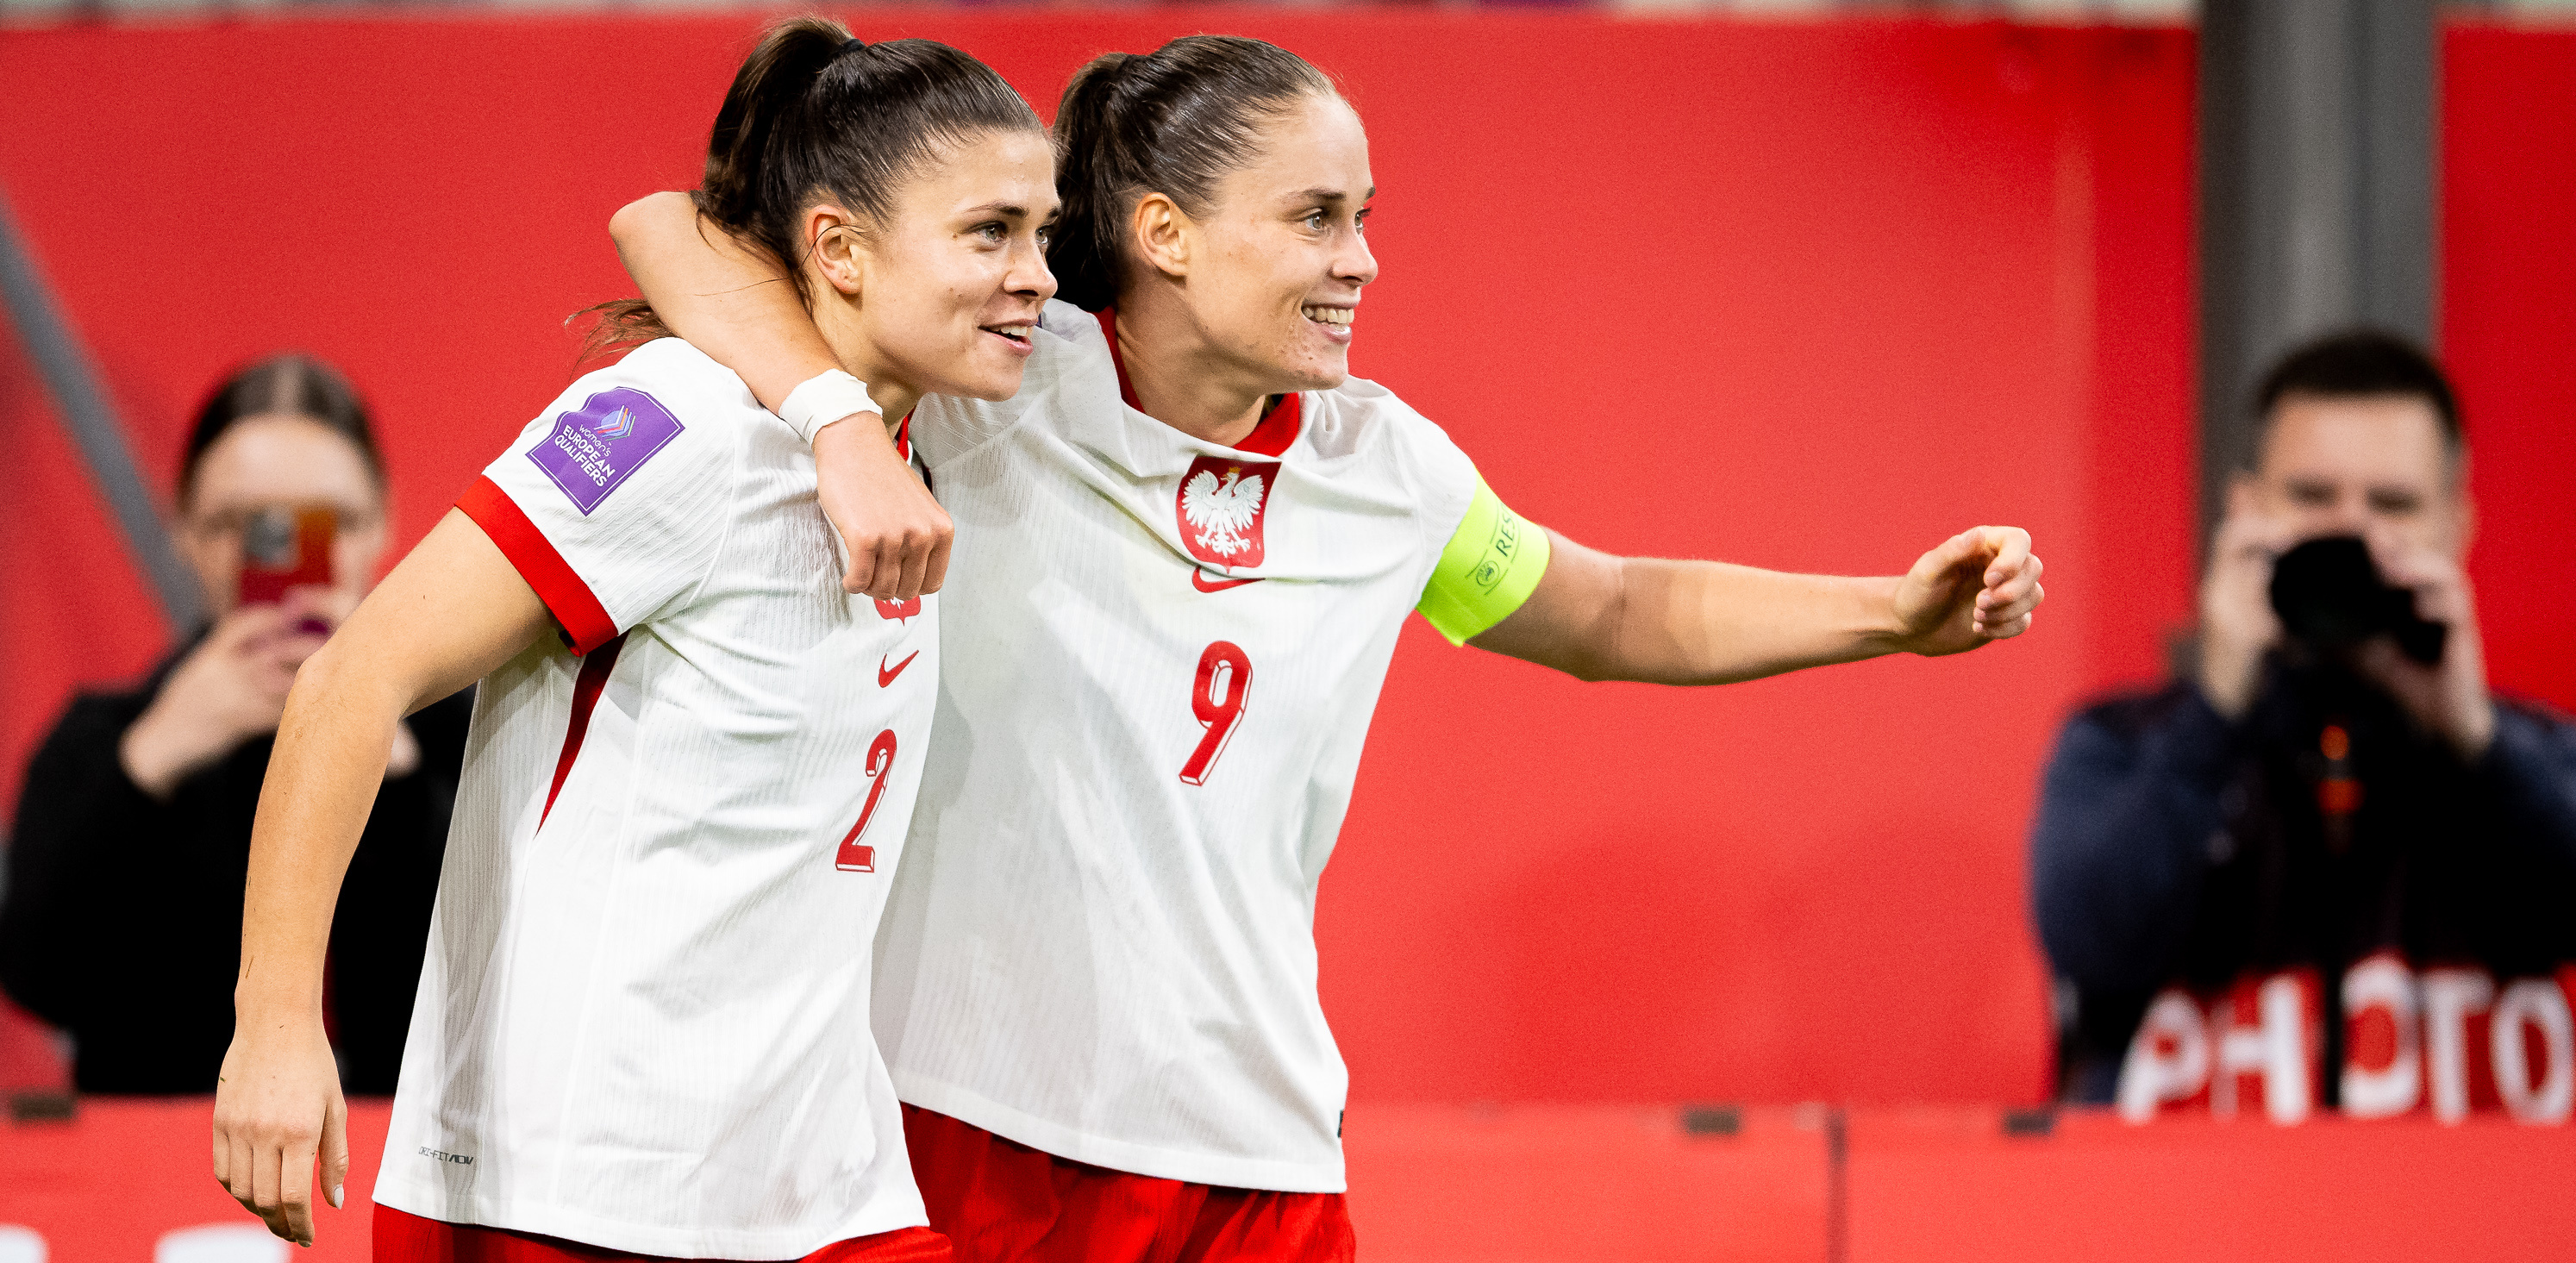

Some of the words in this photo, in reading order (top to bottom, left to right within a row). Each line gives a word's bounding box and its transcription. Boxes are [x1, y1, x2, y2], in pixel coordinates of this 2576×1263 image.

[554, 435, 608, 487] QUALIFIERS
[563, 424, 616, 478] EUROPEAN
[579, 424, 611, 457] women's
[1179, 641, 1253, 786] 9
[835, 729, 897, 873] 2
[2115, 954, 2575, 1124] PHOTO
